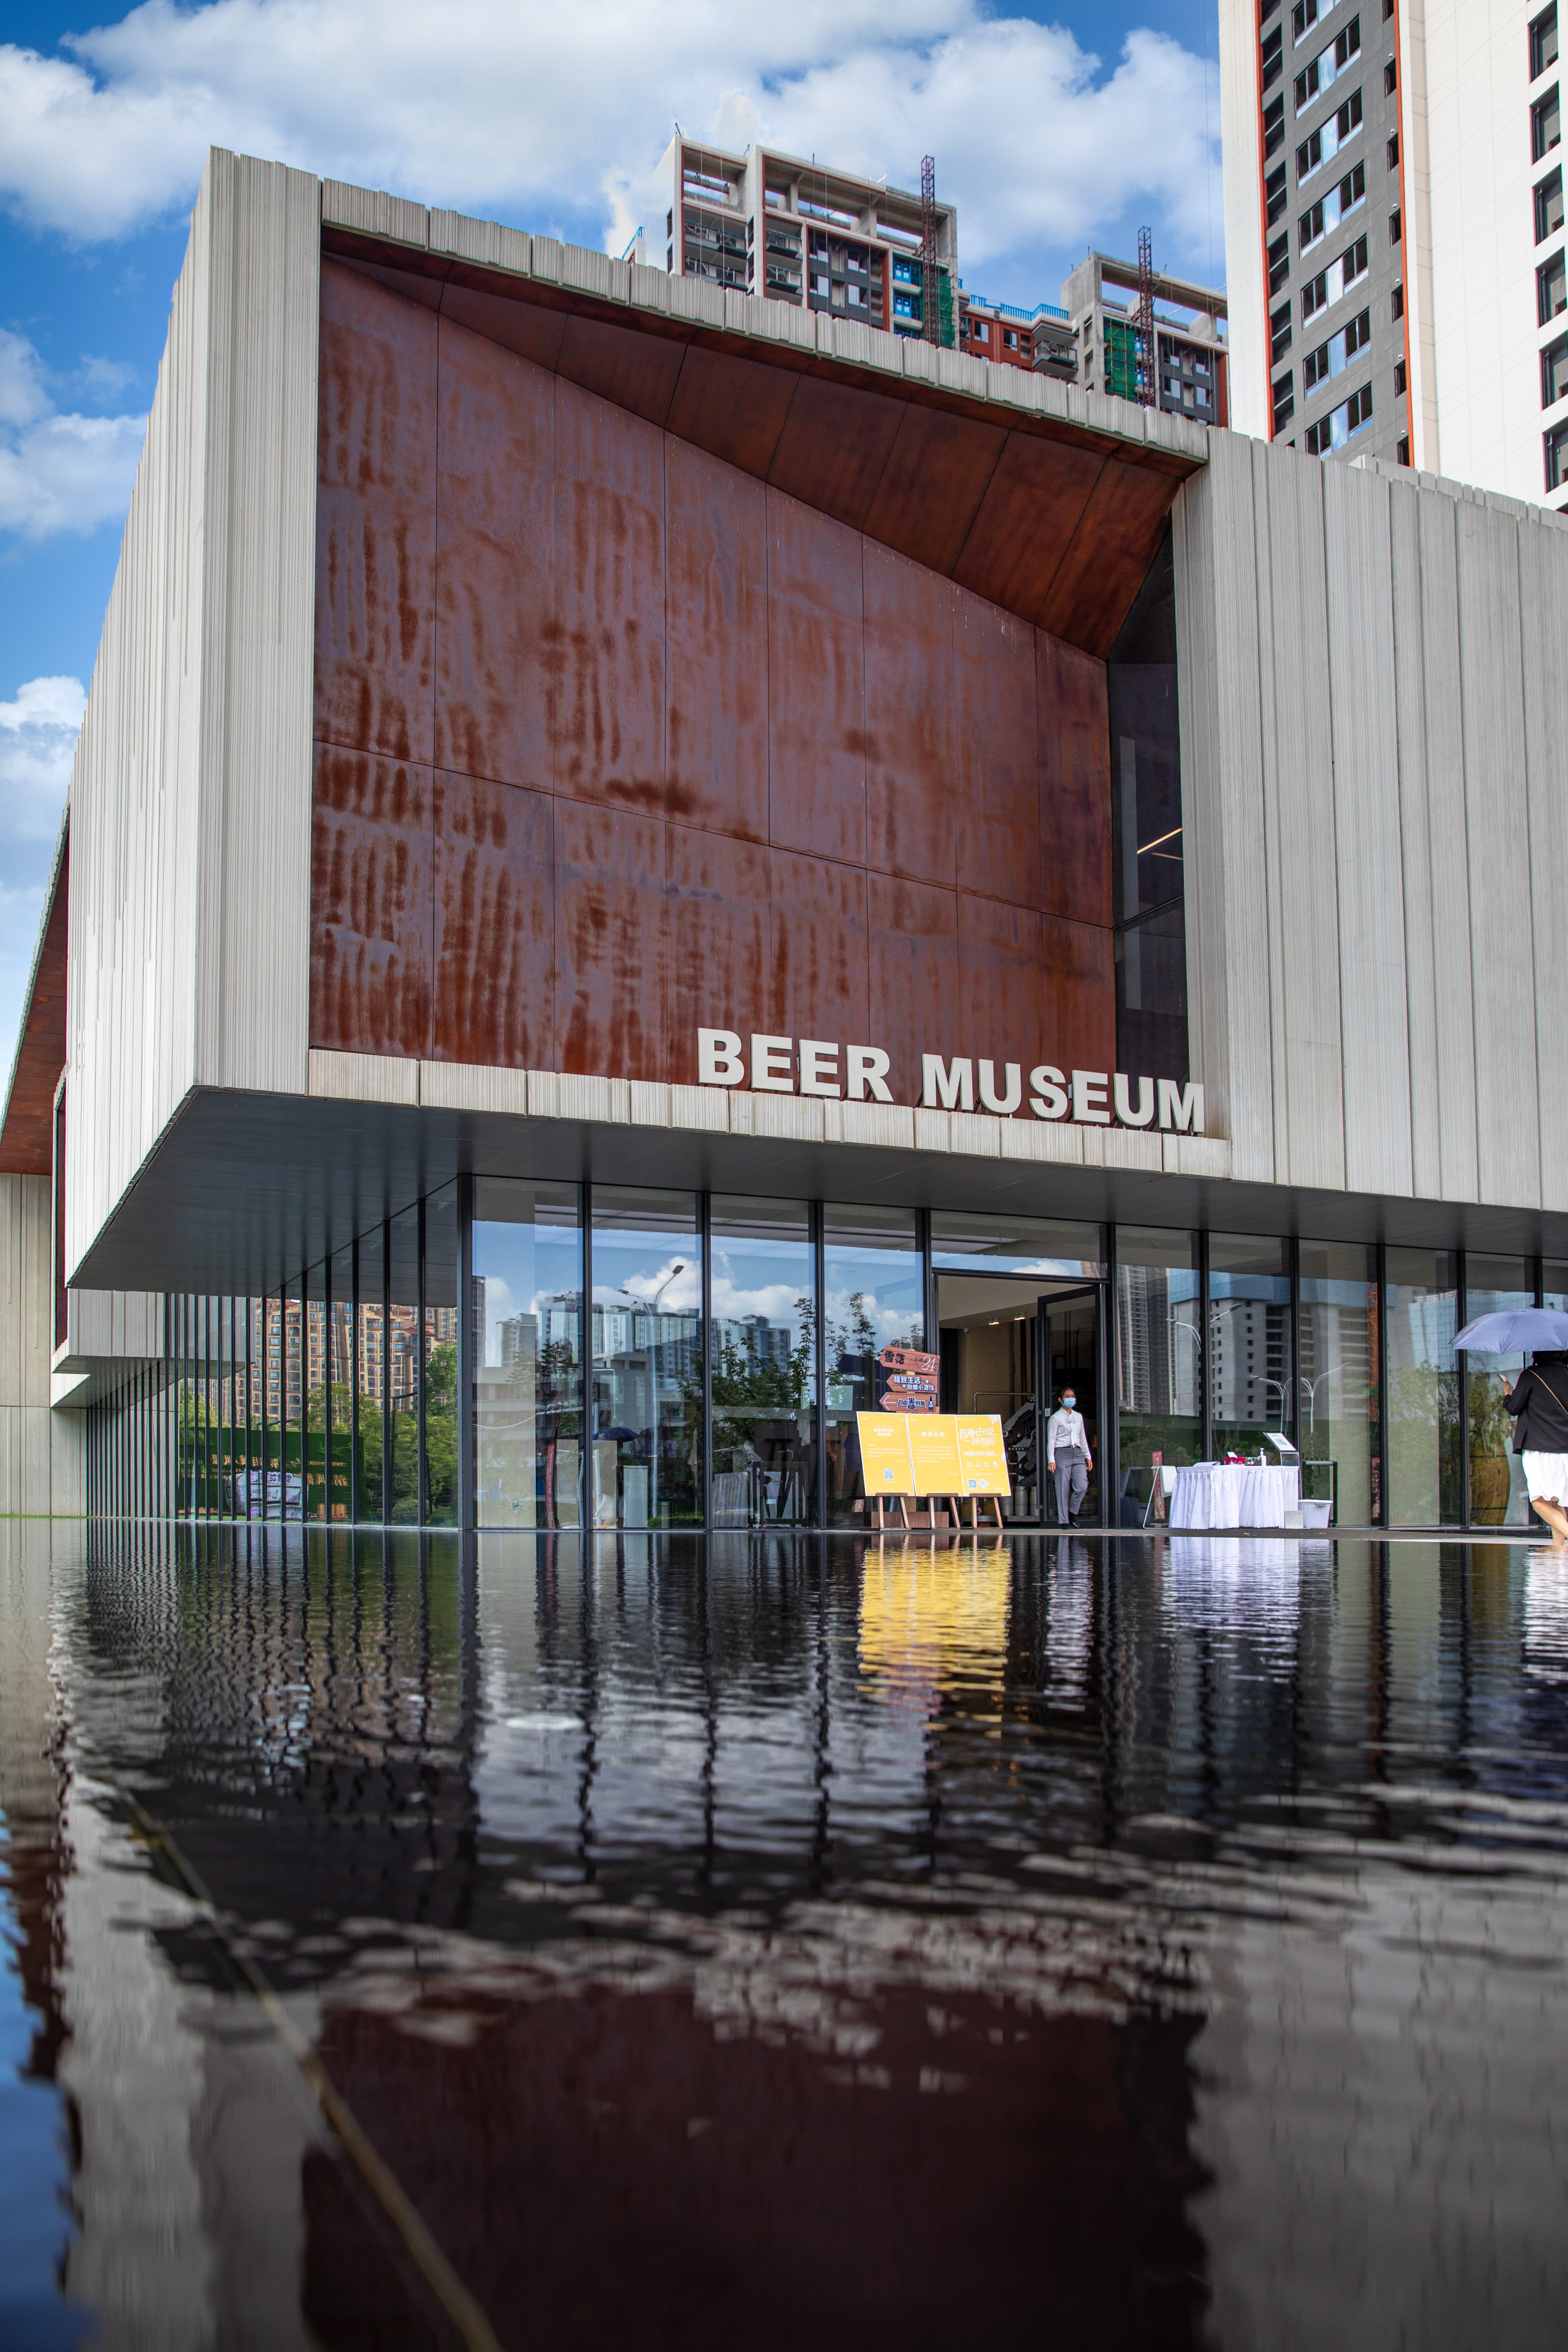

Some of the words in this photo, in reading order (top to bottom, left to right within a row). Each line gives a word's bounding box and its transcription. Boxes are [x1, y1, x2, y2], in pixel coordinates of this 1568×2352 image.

[697, 1028, 893, 1102] BEER
[922, 1053, 1204, 1134] MUSEUM
[884, 1350, 906, 1365] 雪花
[921, 1356, 936, 1372] 24
[893, 1376, 921, 1384] 精致生活
[963, 1437, 996, 1448] 一呼百应
